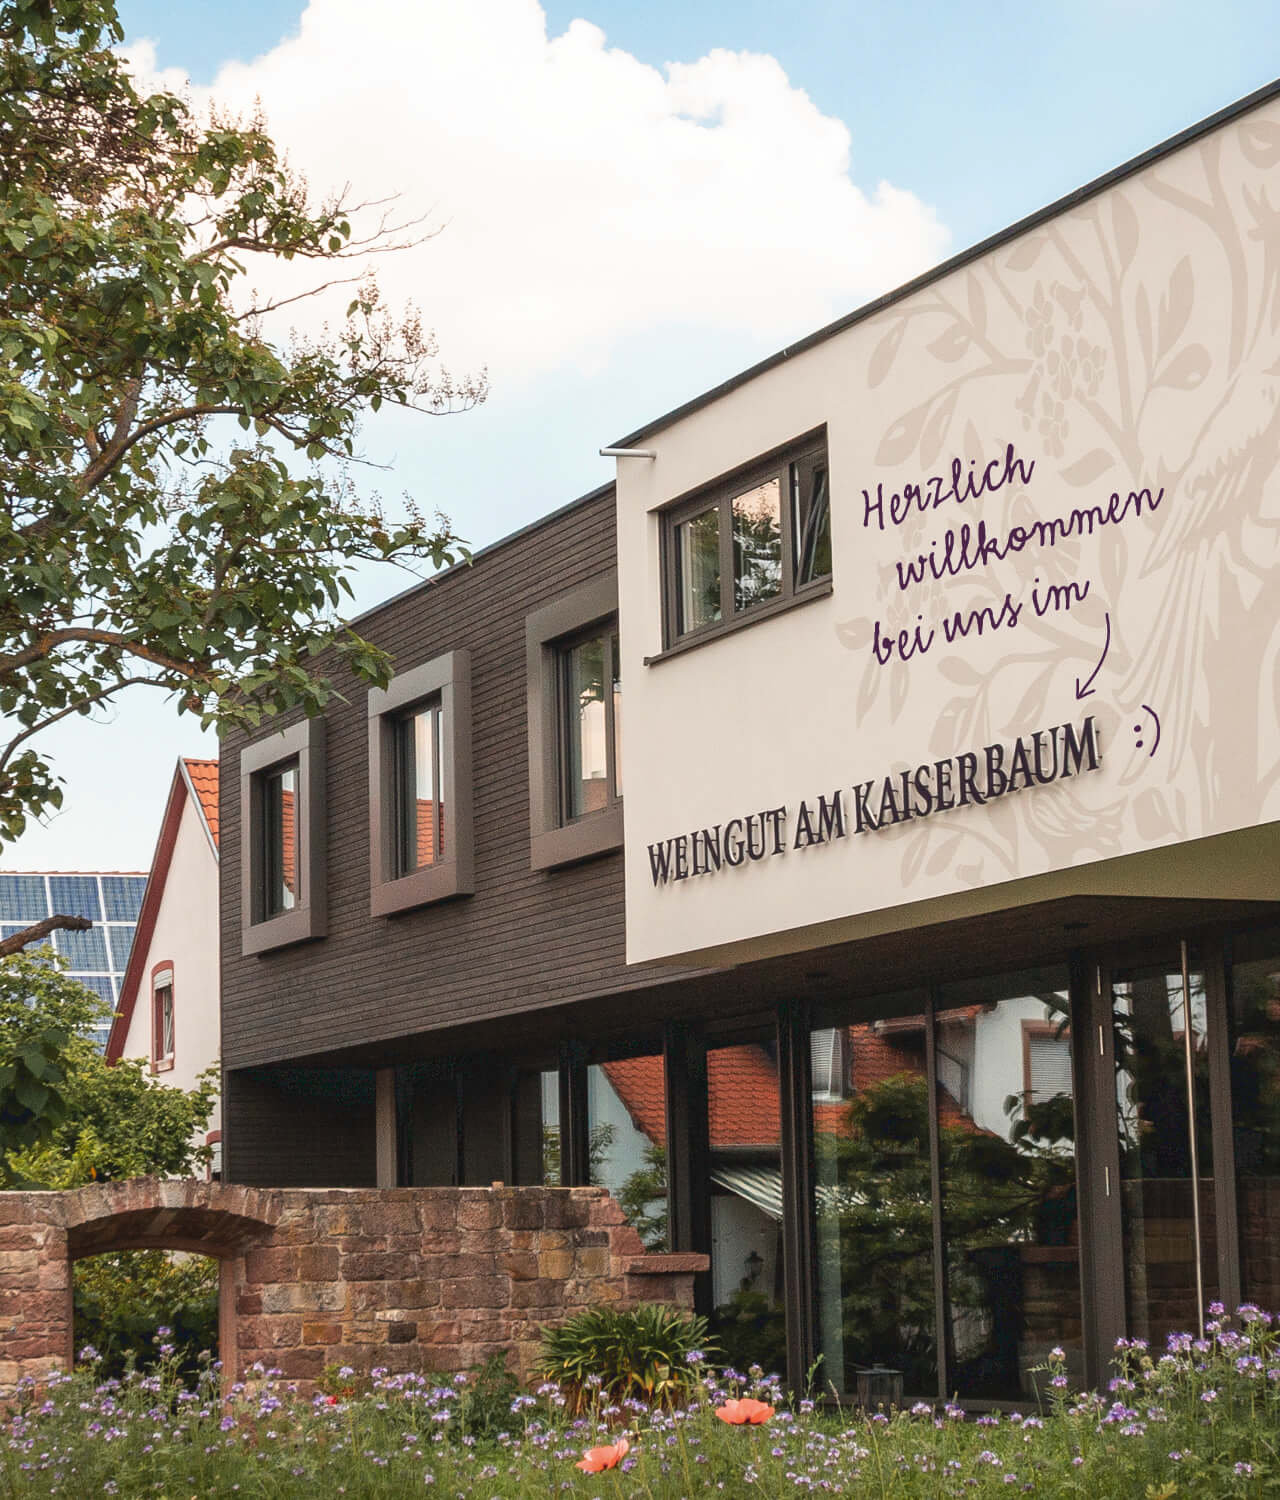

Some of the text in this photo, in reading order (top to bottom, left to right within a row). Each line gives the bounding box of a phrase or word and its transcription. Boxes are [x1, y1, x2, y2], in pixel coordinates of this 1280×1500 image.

[647, 715, 1100, 887] WEINGUT AM KAISERBAUM
